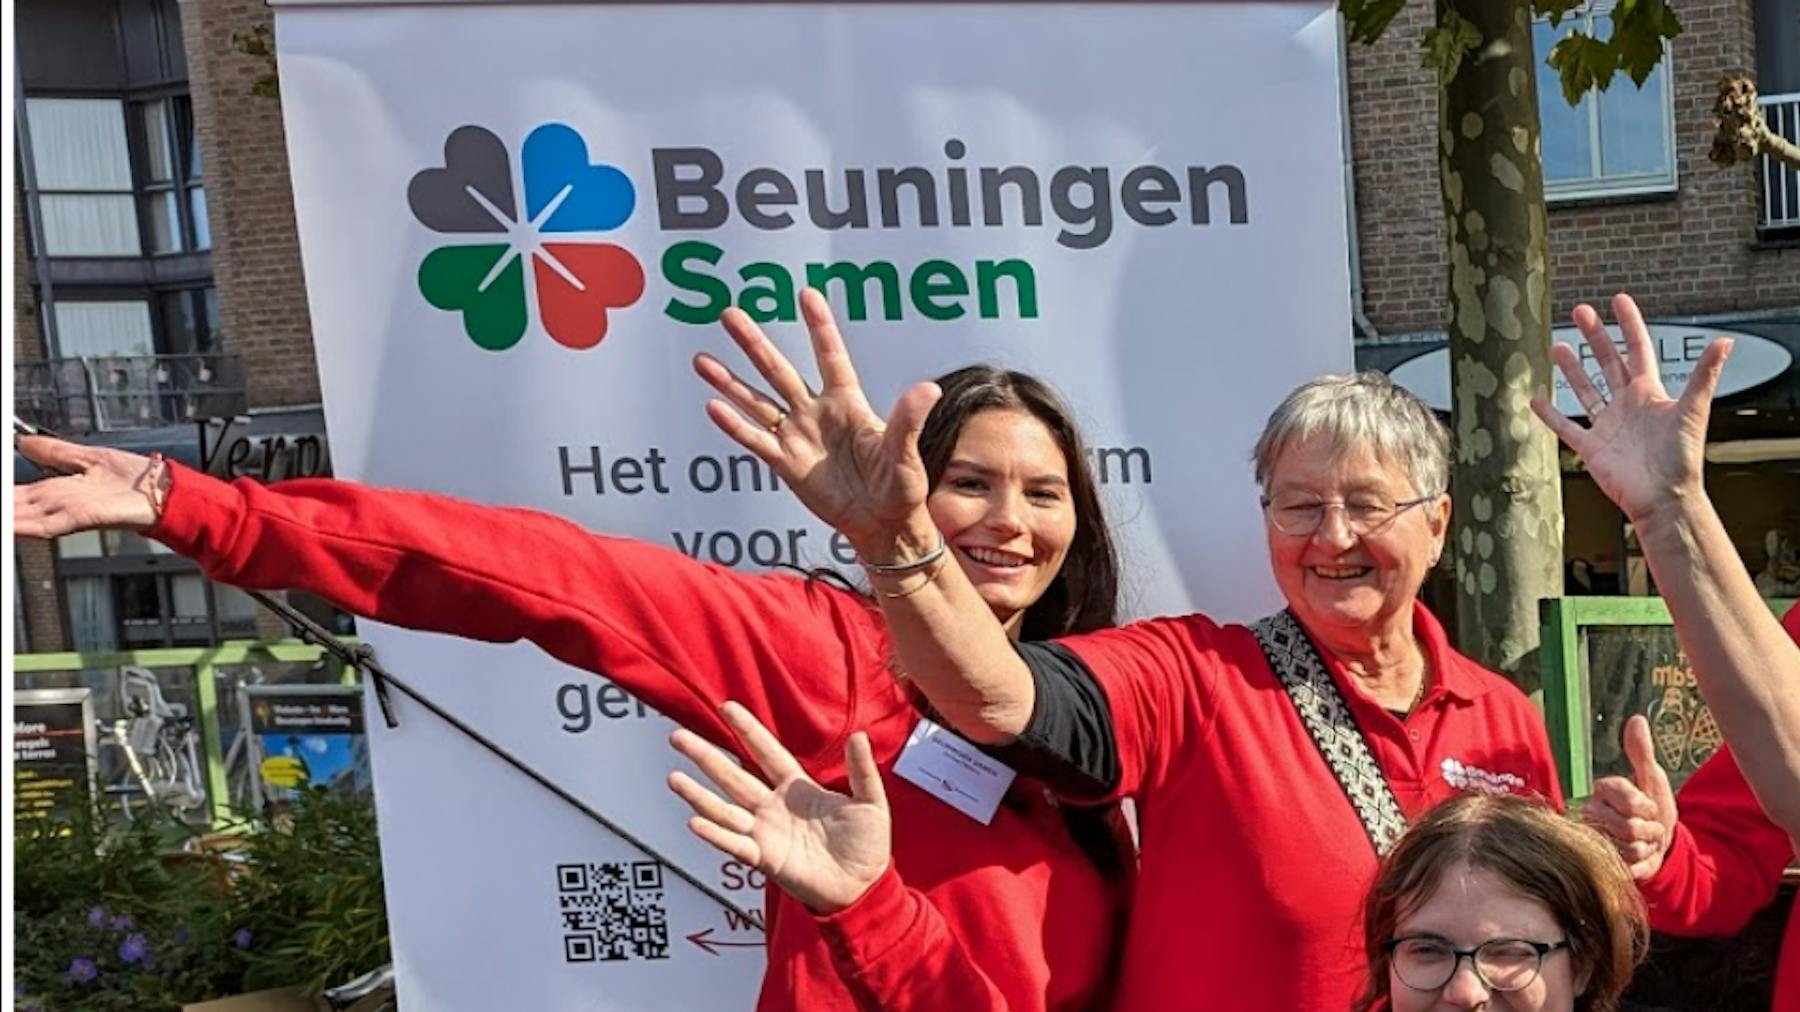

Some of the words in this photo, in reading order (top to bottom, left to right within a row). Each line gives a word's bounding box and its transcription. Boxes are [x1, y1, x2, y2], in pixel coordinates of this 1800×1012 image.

[651, 139, 1249, 250] Beuningen
[661, 240, 1039, 325] Samen
[558, 446, 669, 496] Het
[671, 528, 807, 569] voor
[556, 683, 647, 734] ge
[721, 861, 767, 891] Sc
